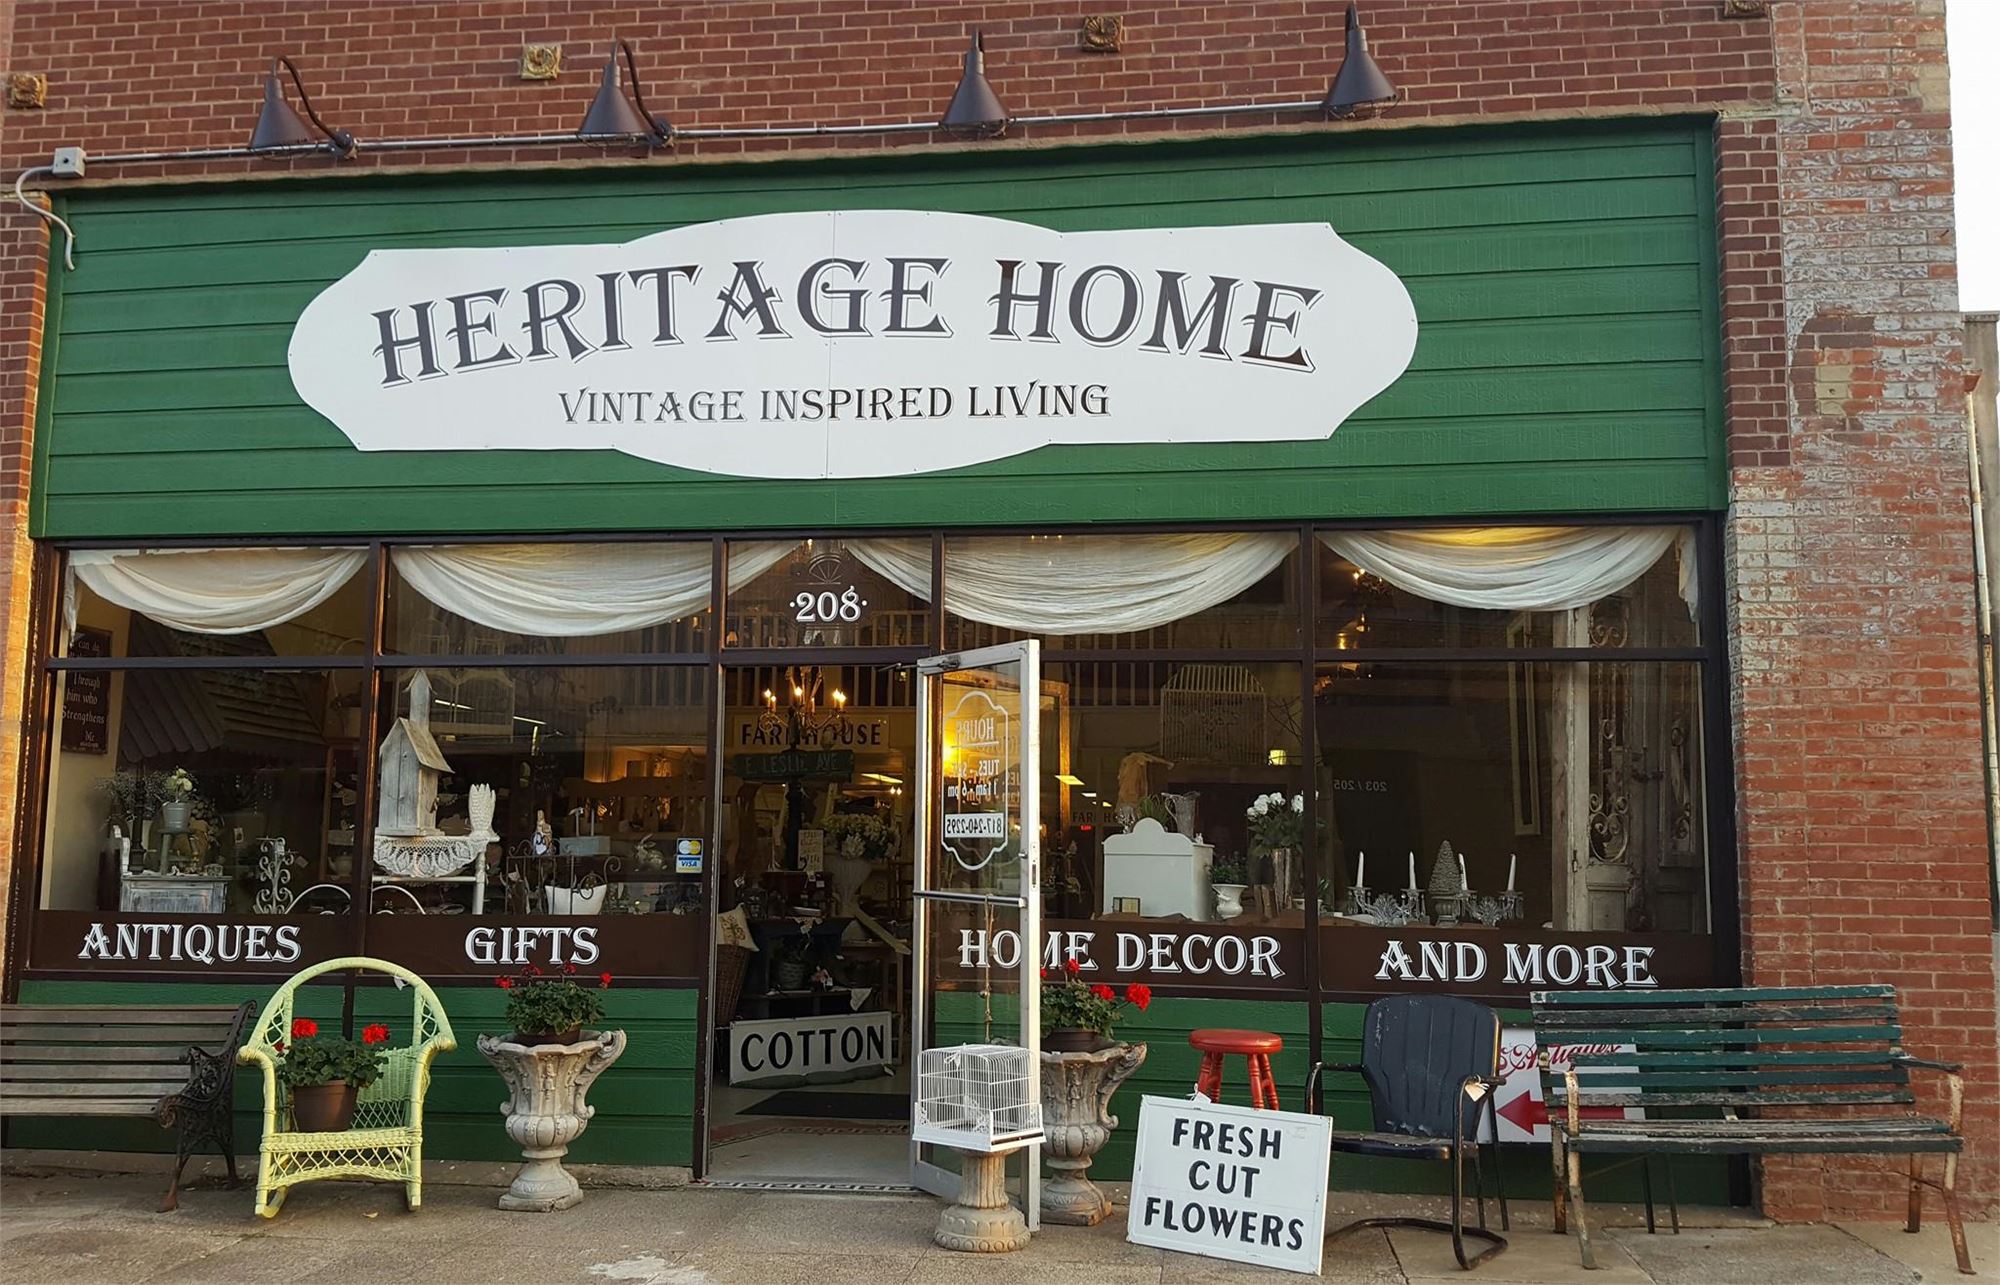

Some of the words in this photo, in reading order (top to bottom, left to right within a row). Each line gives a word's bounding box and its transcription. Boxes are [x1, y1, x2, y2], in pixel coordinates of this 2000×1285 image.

[371, 257, 953, 389] HERITAGE
[987, 259, 1324, 373] HOME
[558, 386, 744, 424] VINTAGE
[760, 386, 953, 422] INSPIRED
[967, 379, 1111, 418] LIVING
[62, 705, 105, 726] Strengthens
[78, 923, 302, 965] ANTIQUES
[464, 926, 600, 965] GIFTS
[1116, 932, 1286, 980] DECOR
[1374, 940, 1489, 982] AND
[1502, 943, 1659, 990] MORE
[740, 1024, 885, 1072] COTTON
[1172, 1117, 1282, 1160] FRESH
[1188, 1160, 1260, 1198] CUT
[1143, 1196, 1304, 1251] FLOWERS
